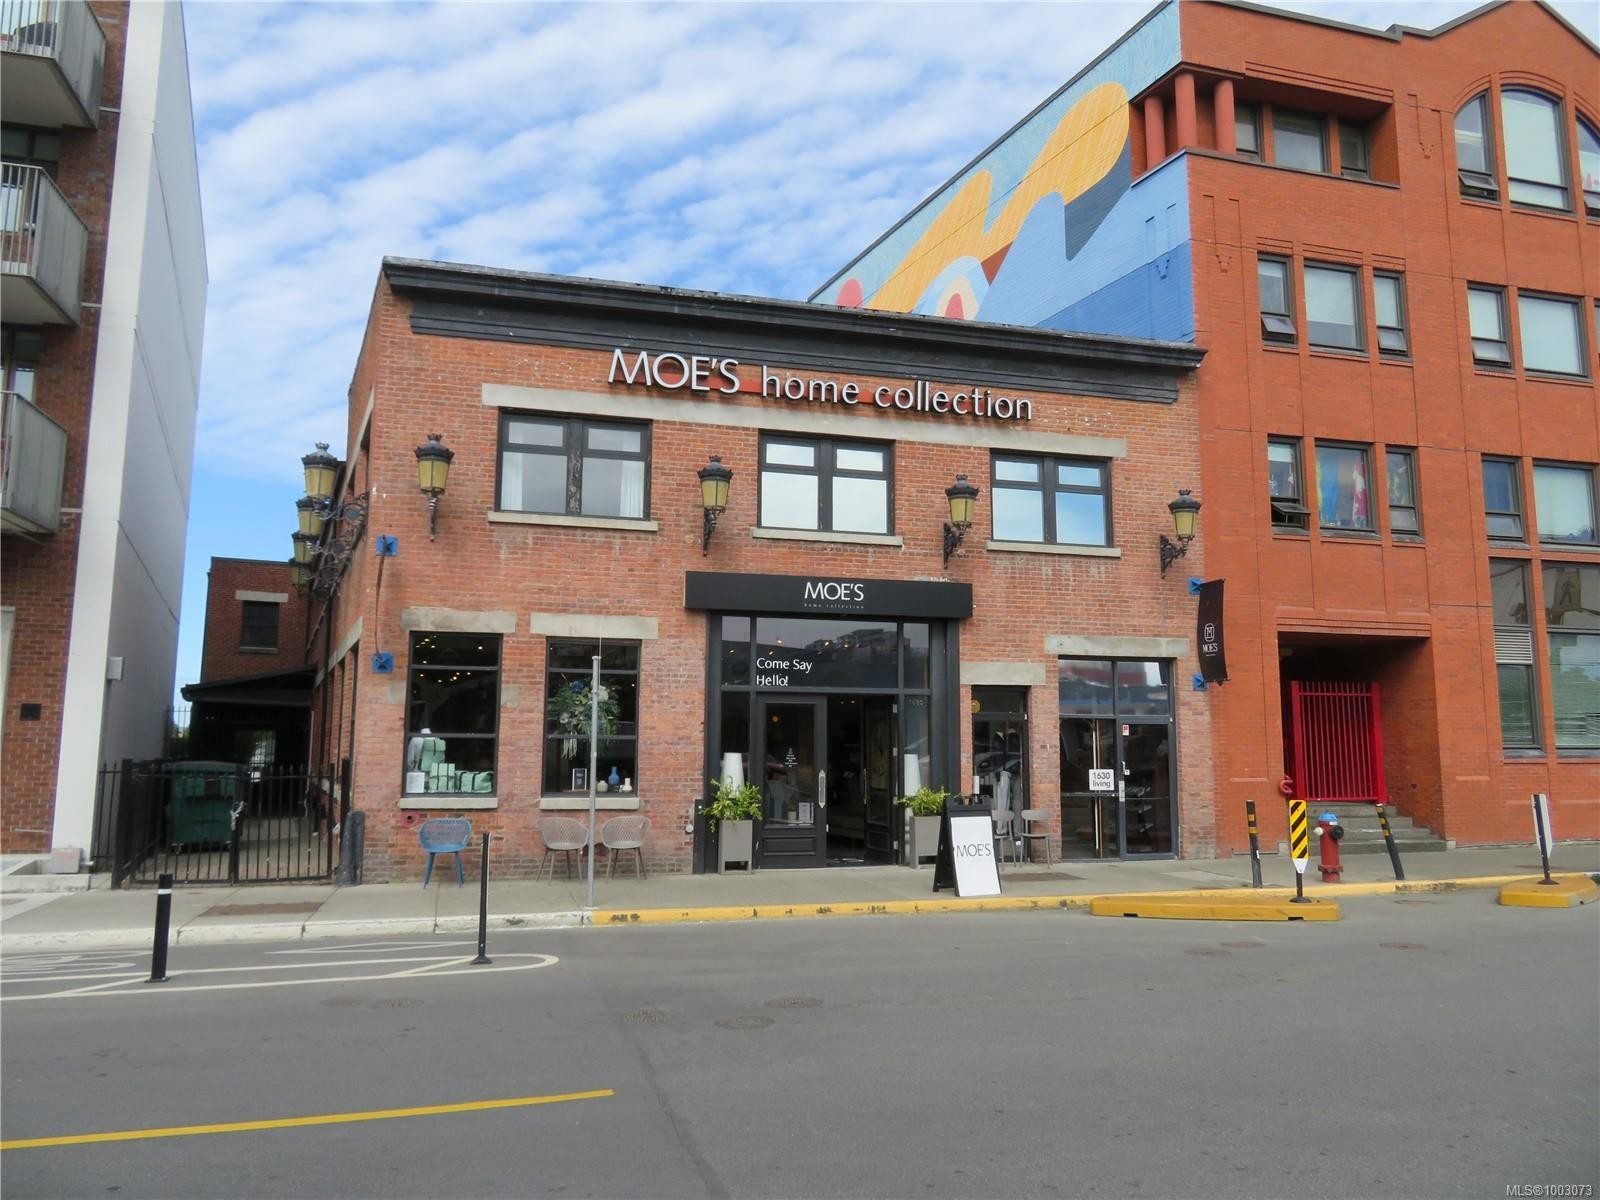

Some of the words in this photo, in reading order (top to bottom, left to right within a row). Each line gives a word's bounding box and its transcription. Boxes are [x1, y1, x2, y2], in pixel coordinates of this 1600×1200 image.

[608, 348, 740, 393] MOE'S
[762, 365, 860, 404] home
[874, 380, 1034, 420] collection
[804, 581, 864, 601] MOE'S
[756, 657, 790, 670] Come
[792, 659, 813, 674] Say
[756, 674, 789, 687] Hello!
[1093, 771, 1111, 780] 1630
[1092, 780, 1111, 789] living
